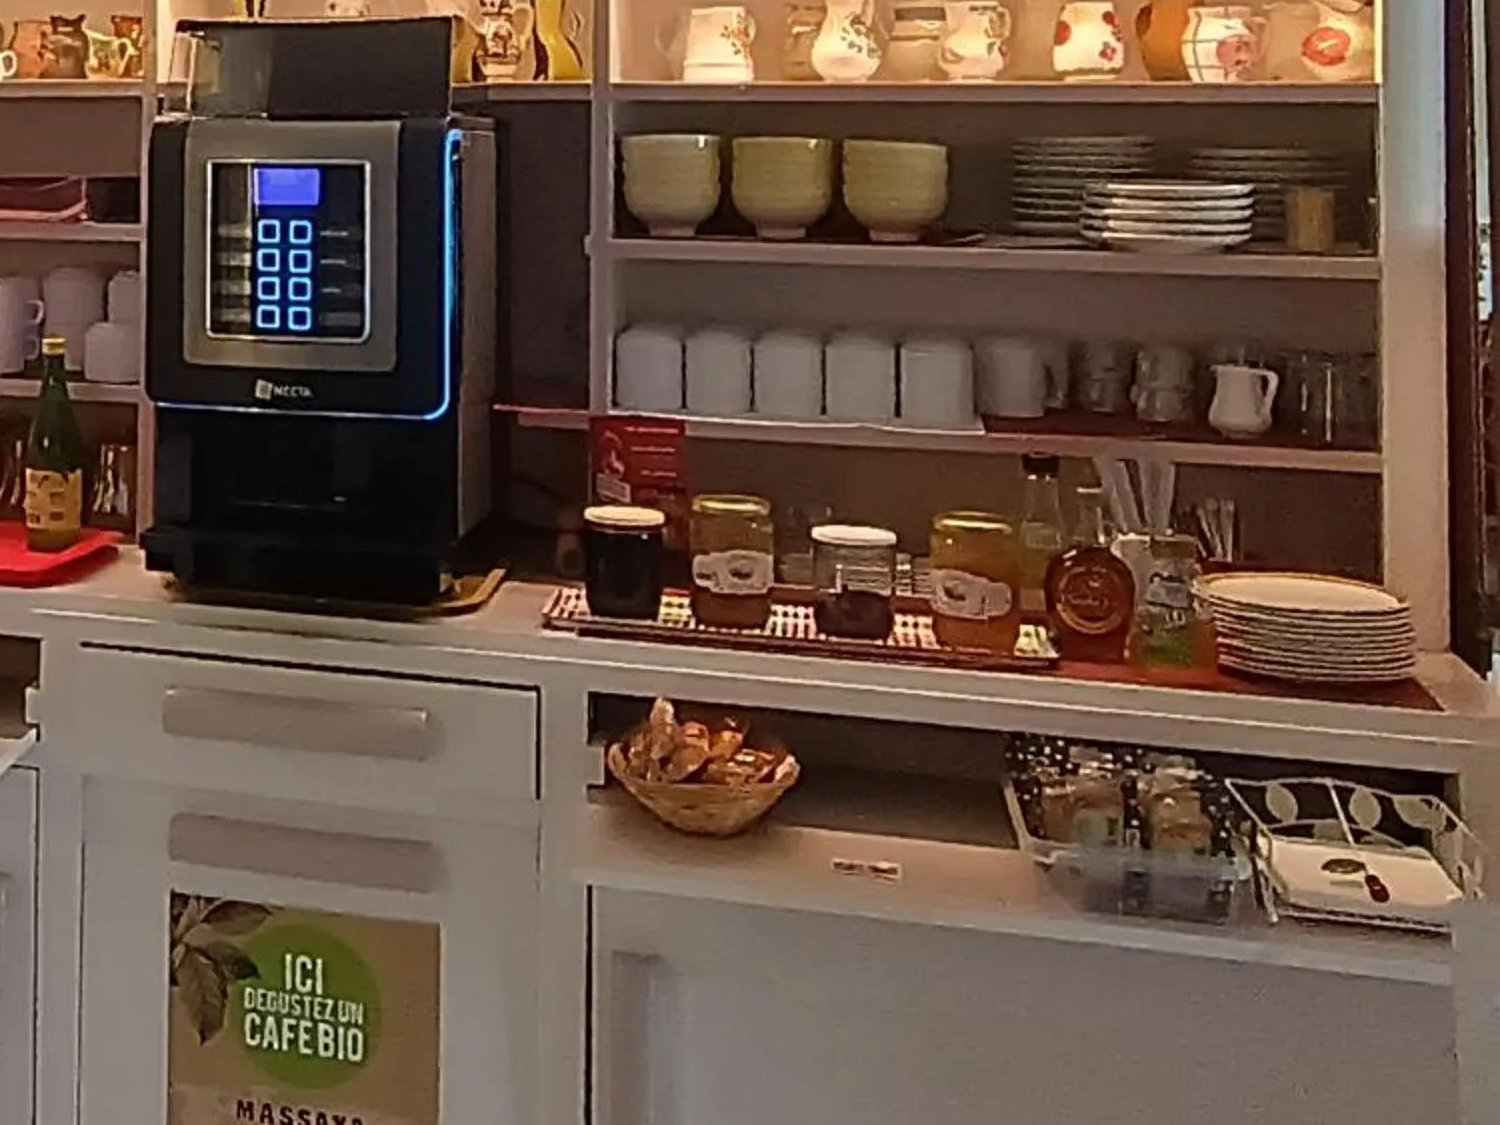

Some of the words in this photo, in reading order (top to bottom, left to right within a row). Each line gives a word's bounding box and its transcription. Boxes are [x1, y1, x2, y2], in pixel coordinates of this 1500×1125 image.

[284, 952, 323, 995] ICI
[244, 986, 334, 1022] DEGUSTEZ
[338, 1000, 363, 1025] UN
[244, 1012, 314, 1055] CAFE
[318, 1022, 363, 1062] BIO
